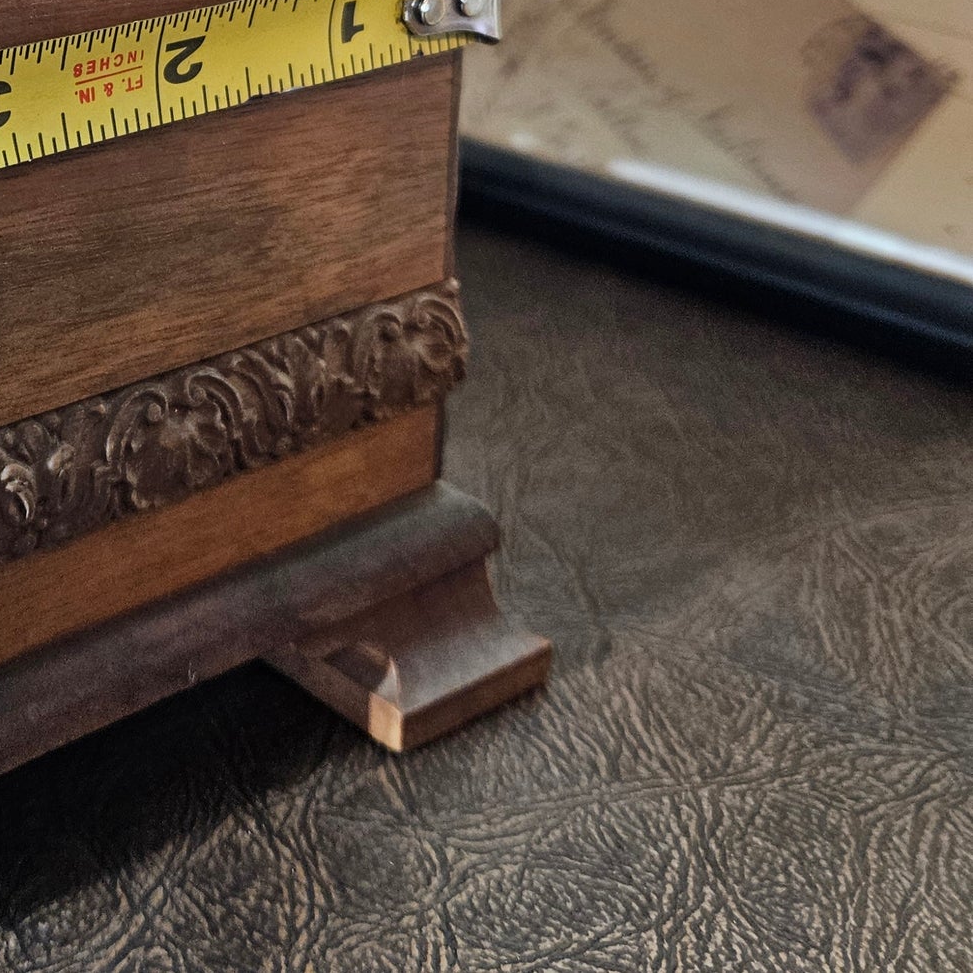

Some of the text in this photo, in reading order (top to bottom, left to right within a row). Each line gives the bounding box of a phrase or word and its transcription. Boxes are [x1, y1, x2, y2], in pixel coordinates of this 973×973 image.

[341, 0, 365, 43] 1
[73, 49, 144, 78] INCHES
[163, 35, 206, 84] 2
[74, 74, 143, 105] FT. & IN.
